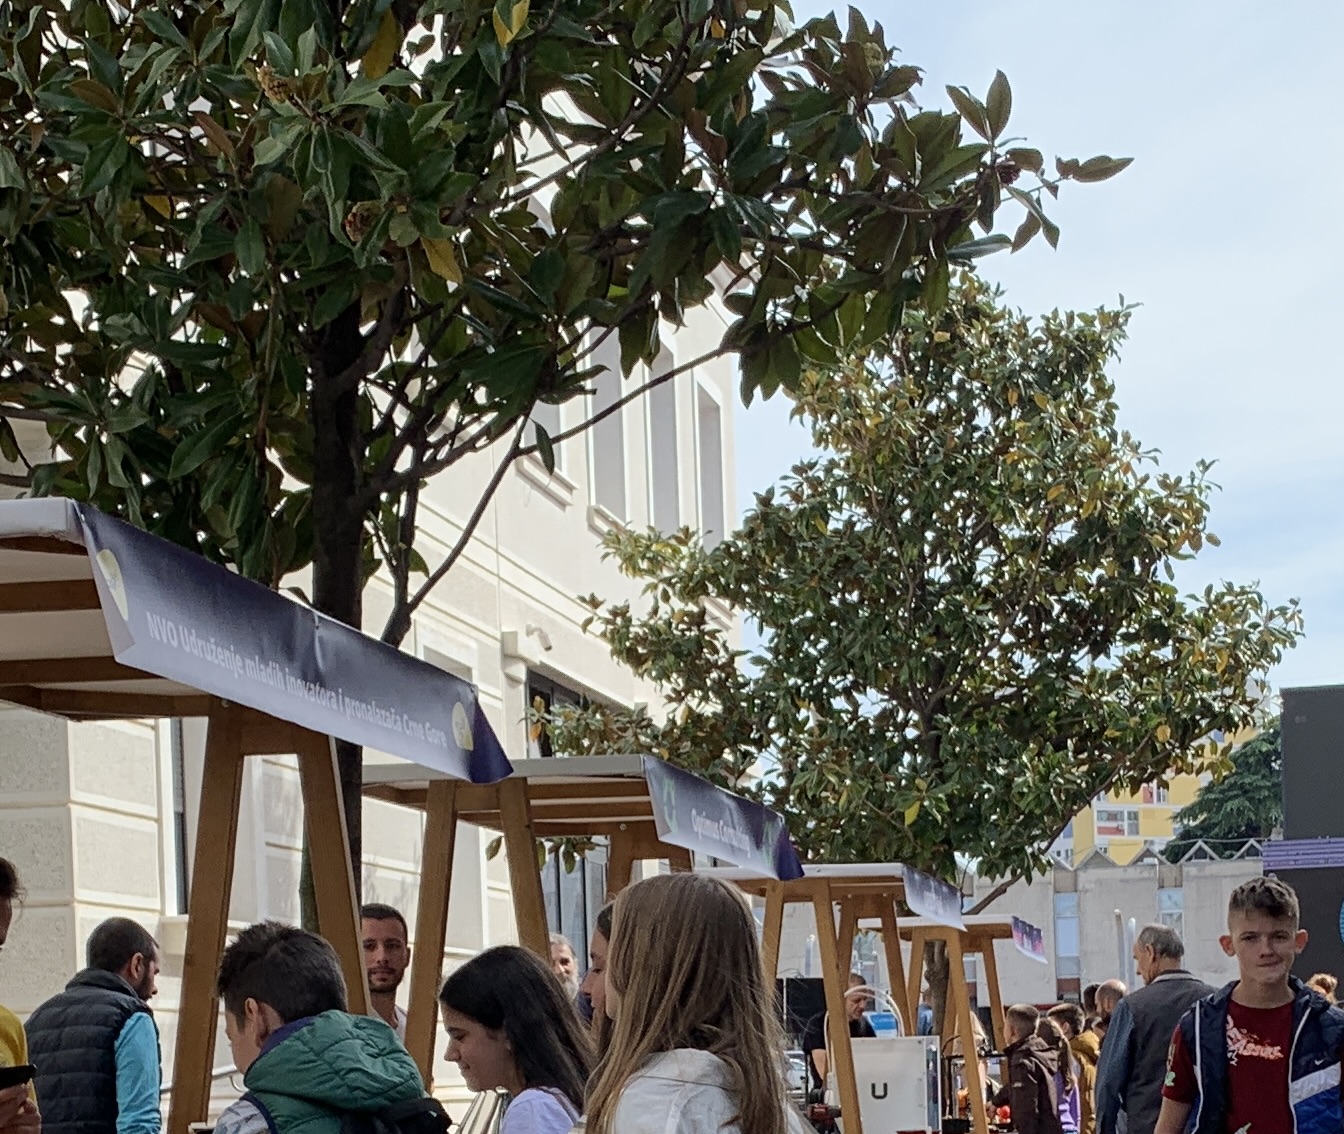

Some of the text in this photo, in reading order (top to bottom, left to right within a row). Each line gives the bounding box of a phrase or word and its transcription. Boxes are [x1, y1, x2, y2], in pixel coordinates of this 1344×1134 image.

[146, 610, 178, 648] NVO
[179, 624, 244, 679] Udruženje
[244, 654, 286, 691] mladih
[285, 667, 340, 710] inovatora
[871, 1082, 888, 1099] U
